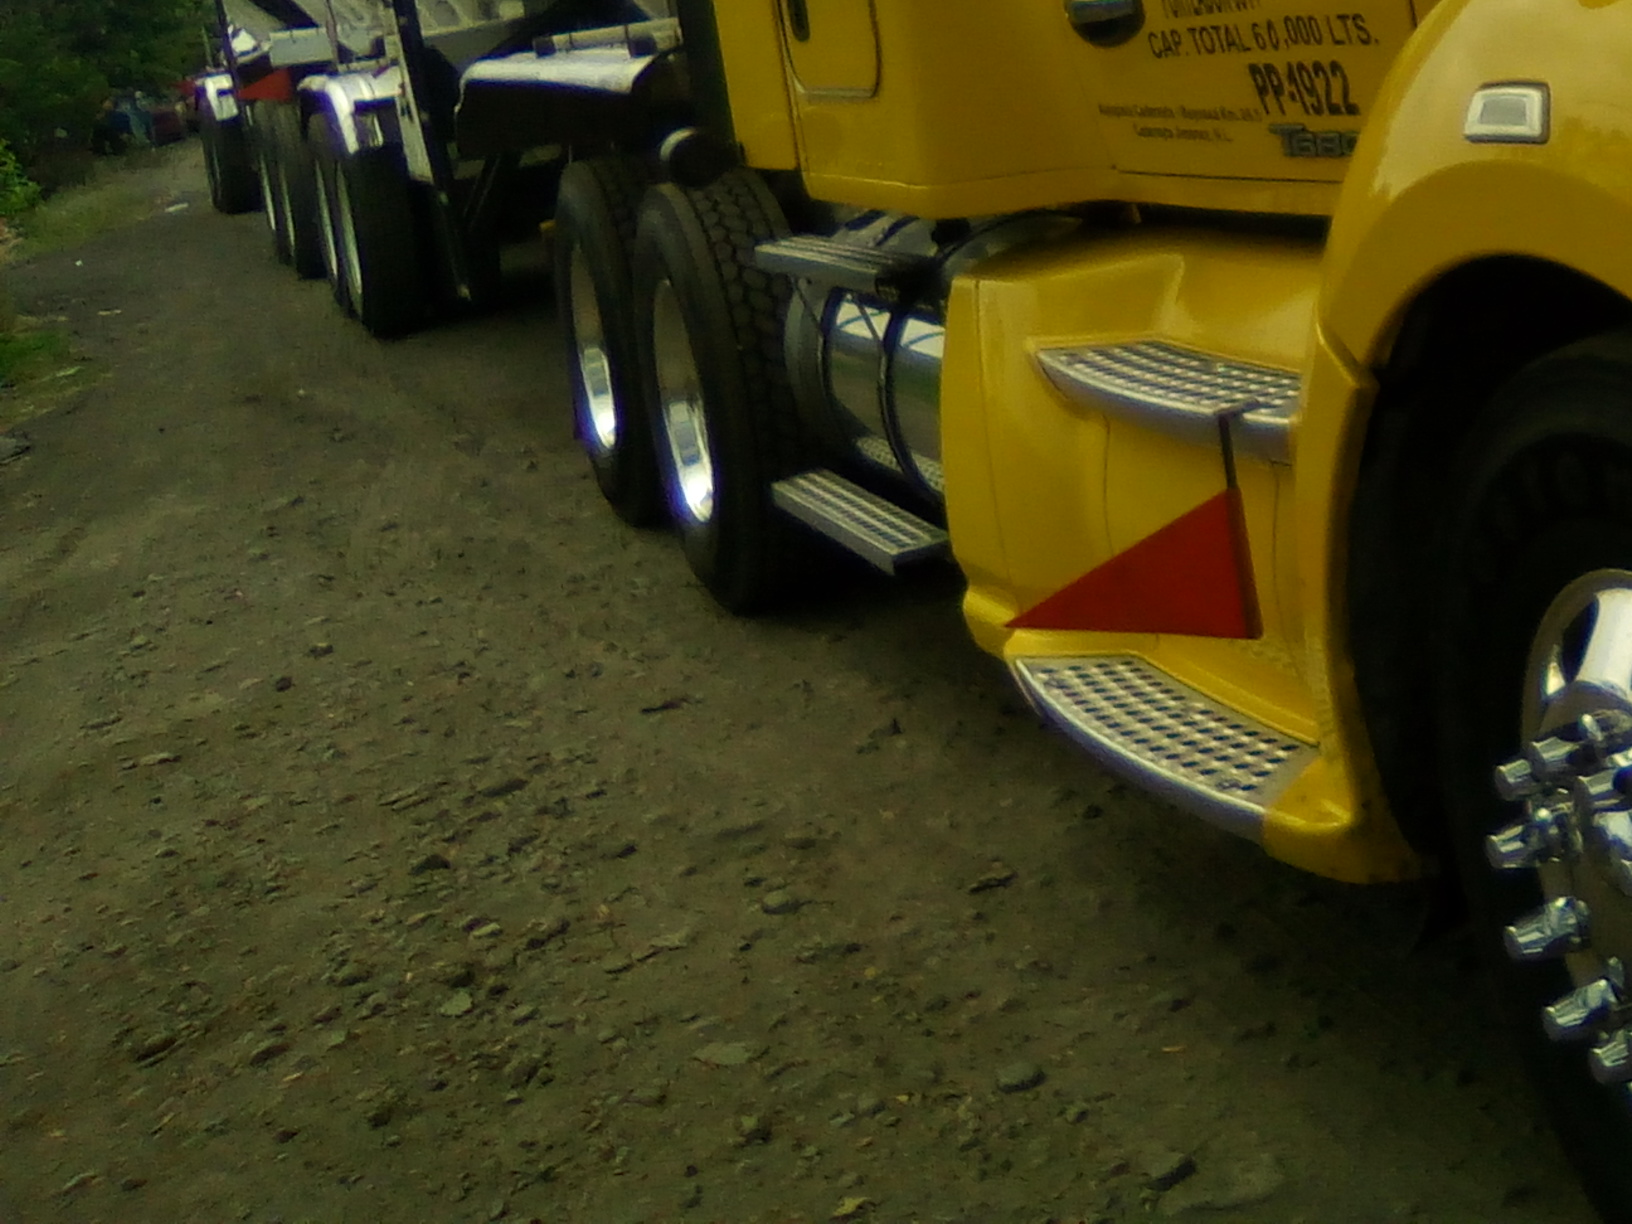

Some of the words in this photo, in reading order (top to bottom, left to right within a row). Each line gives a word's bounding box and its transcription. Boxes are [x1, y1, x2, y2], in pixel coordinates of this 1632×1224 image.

[1187, 24, 1252, 55] TOTAL
[1252, 15, 1323, 52] 60,000
[1325, 13, 1380, 45] LTS.
